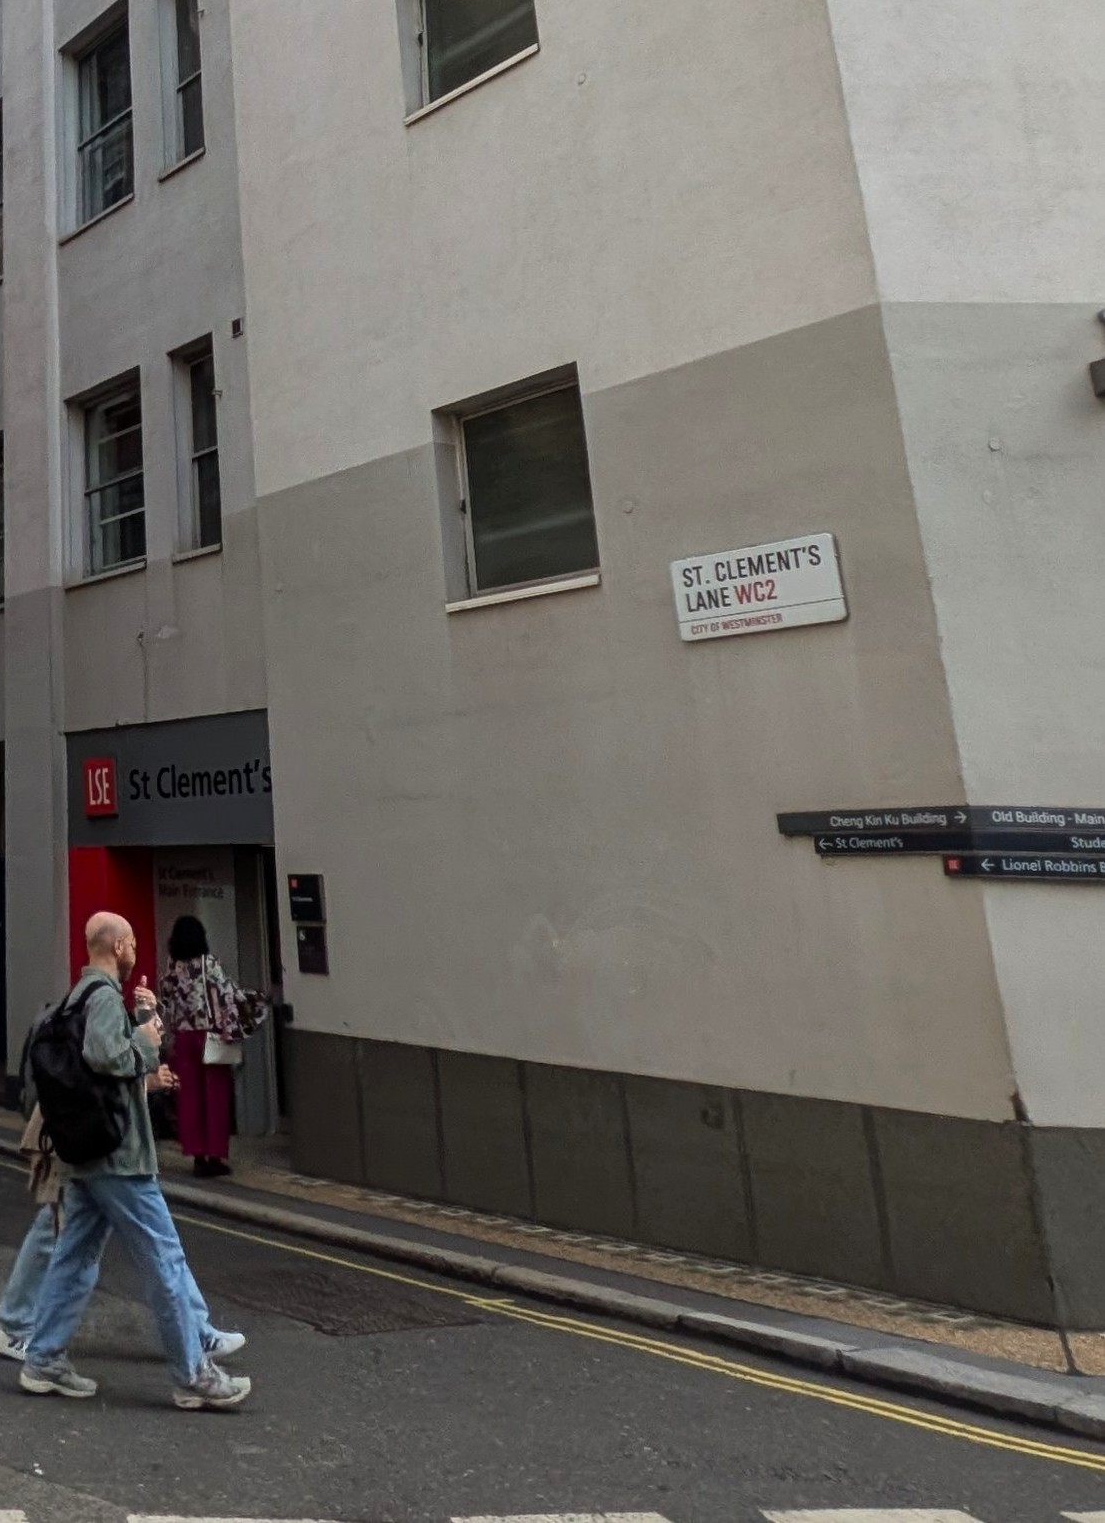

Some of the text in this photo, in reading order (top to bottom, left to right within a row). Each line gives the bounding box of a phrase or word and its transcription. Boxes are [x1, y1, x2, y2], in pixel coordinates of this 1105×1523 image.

[682, 545, 822, 588] ST. CLEMENT'S
[686, 579, 778, 613] LANE WC2
[691, 613, 783, 635] CITY OF WESTMINSTER
[88, 768, 111, 806] LSE
[129, 759, 272, 801] St Clement's
[830, 813, 947, 829] Cheng Kin Ku Building
[992, 810, 1014, 823] Old
[1015, 811, 1065, 826] Building
[1074, 812, 1105, 825] Main
[835, 836, 903, 849] St Clement's
[1002, 858, 1042, 872] Lionel
[1045, 859, 1097, 873] Robbins
